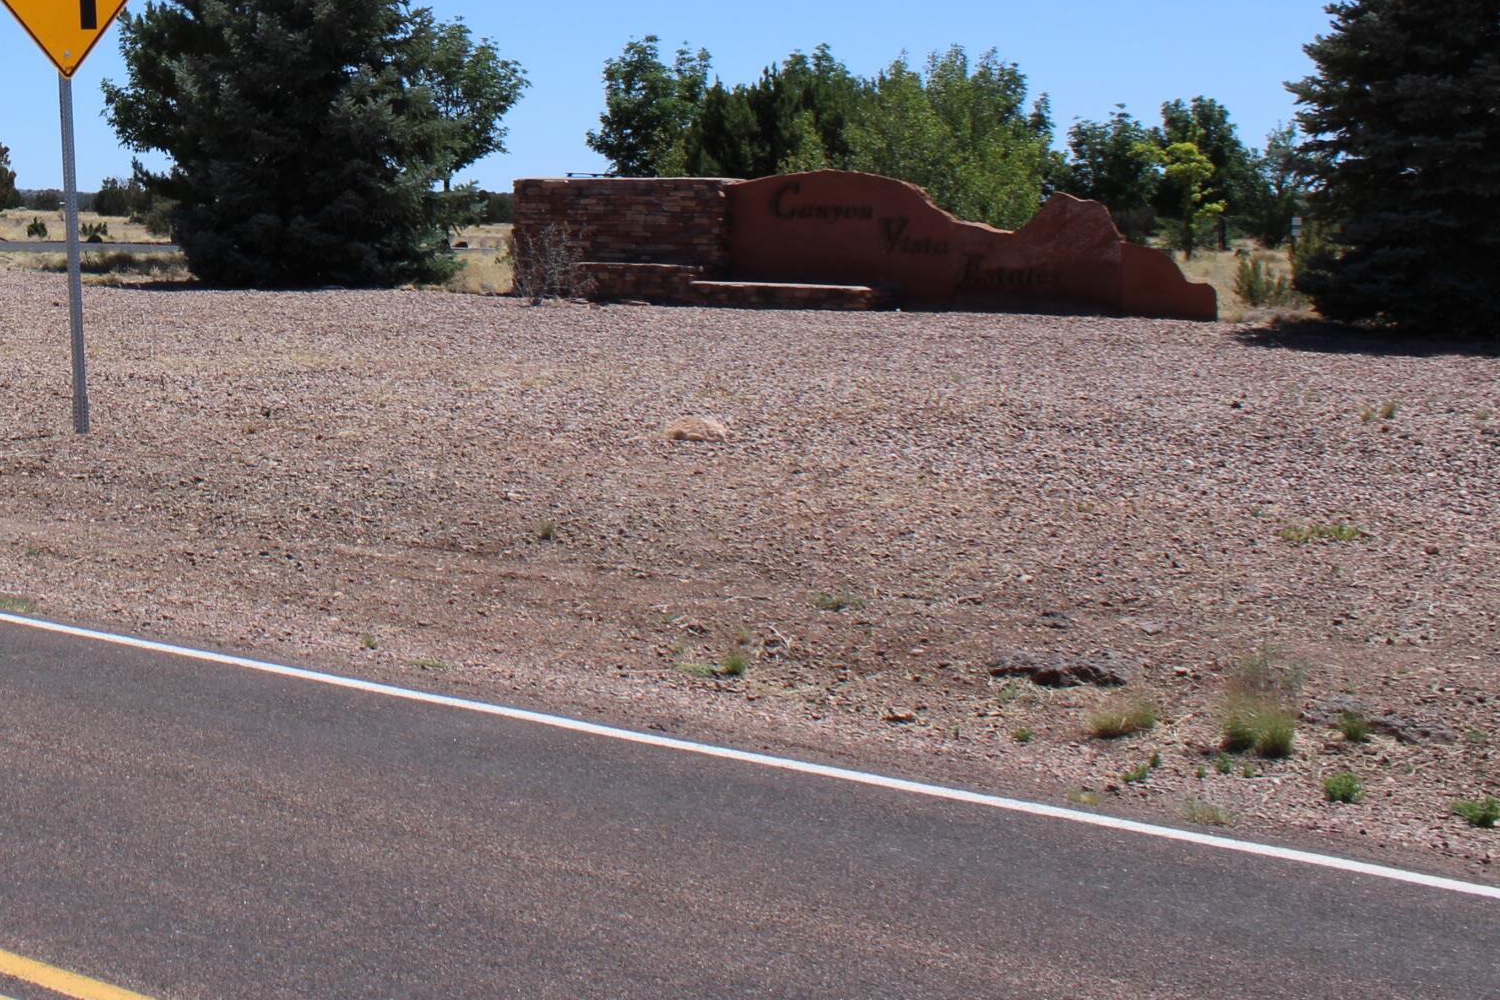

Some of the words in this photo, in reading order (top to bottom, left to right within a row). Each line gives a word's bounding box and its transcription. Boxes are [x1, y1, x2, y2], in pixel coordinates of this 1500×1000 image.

[769, 182, 873, 224] Canyon
[879, 215, 949, 255] Vista
[957, 251, 1063, 289] Estates
